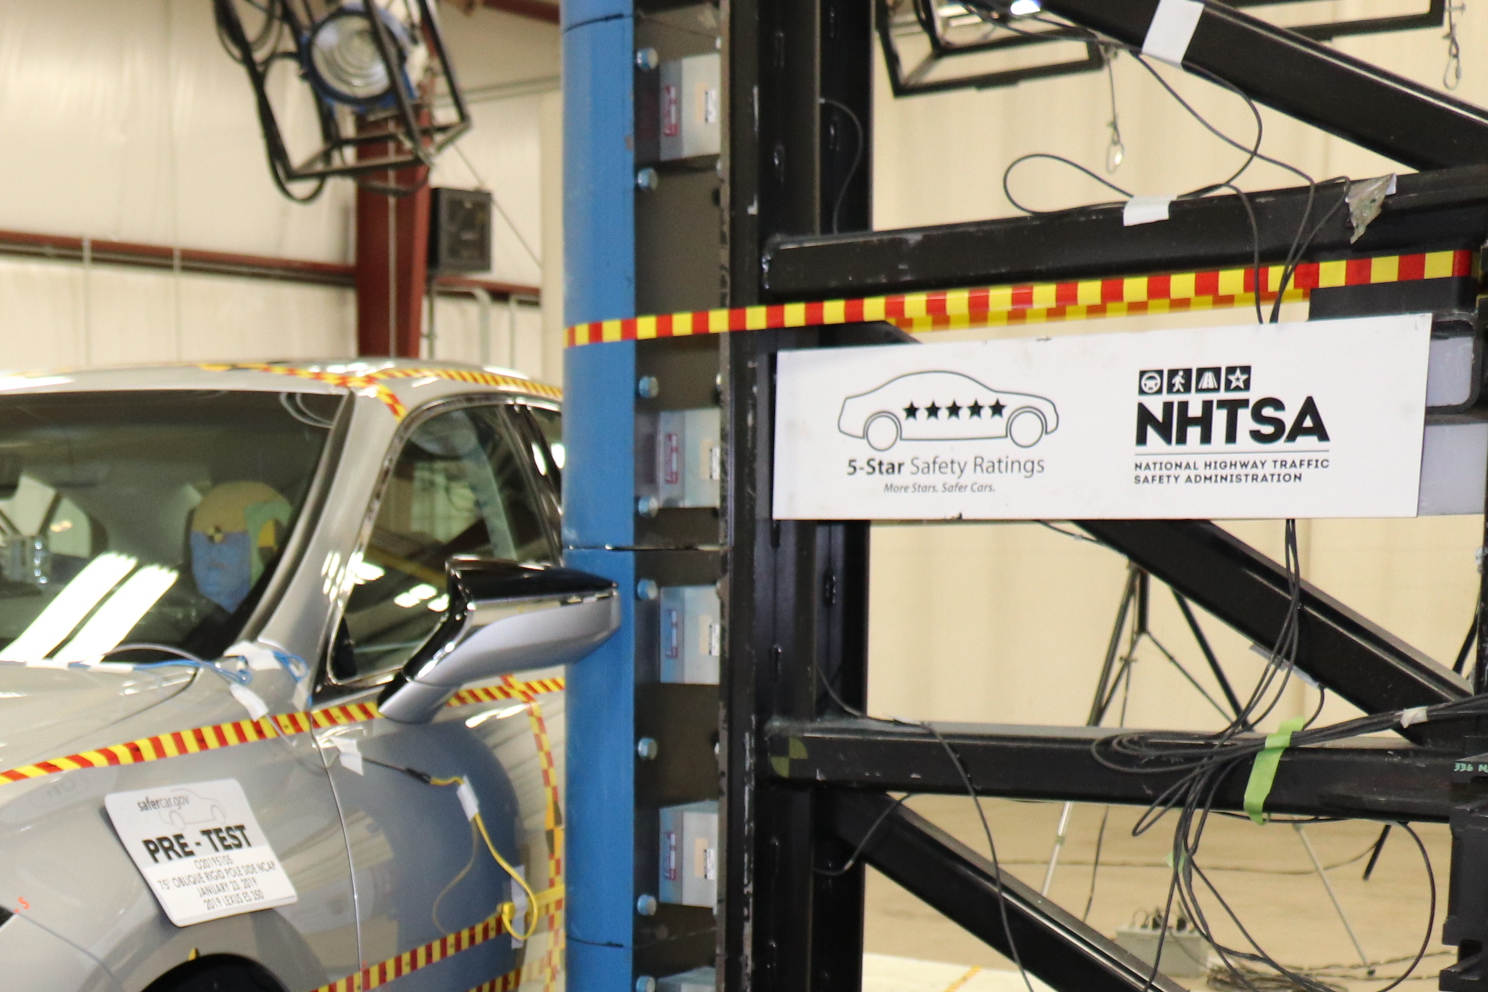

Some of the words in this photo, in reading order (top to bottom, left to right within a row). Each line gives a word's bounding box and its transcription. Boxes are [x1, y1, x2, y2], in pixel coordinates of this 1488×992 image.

[1135, 396, 1331, 446] NHTSA
[846, 457, 905, 476] 5-Star
[910, 456, 968, 479] Safety
[973, 455, 1045, 478] Ratings
[1134, 460, 1199, 471] NATIONAL
[1204, 459, 1268, 470] HIGHWAY
[1272, 458, 1330, 469] TRAFFIC
[1134, 474, 1181, 485] SAFETY
[1184, 473, 1303, 484] ADMINISTRATION
[883, 483, 910, 493] More
[911, 482, 939, 493] Stars.
[941, 482, 969, 493] Safer
[970, 482, 996, 493] Cars.
[137, 795, 190, 811] safercar.gov
[142, 833, 196, 864] PRE
[199, 824, 252, 853] TEST
[171, 872, 204, 889] OBLIQUE
[203, 869, 226, 884] RIGID
[225, 866, 244, 880] POLE
[241, 863, 259, 877] SIDE
[256, 860, 276, 873] NCAP
[197, 881, 232, 898] JANUARY
[222, 893, 244, 907] LEXUS
